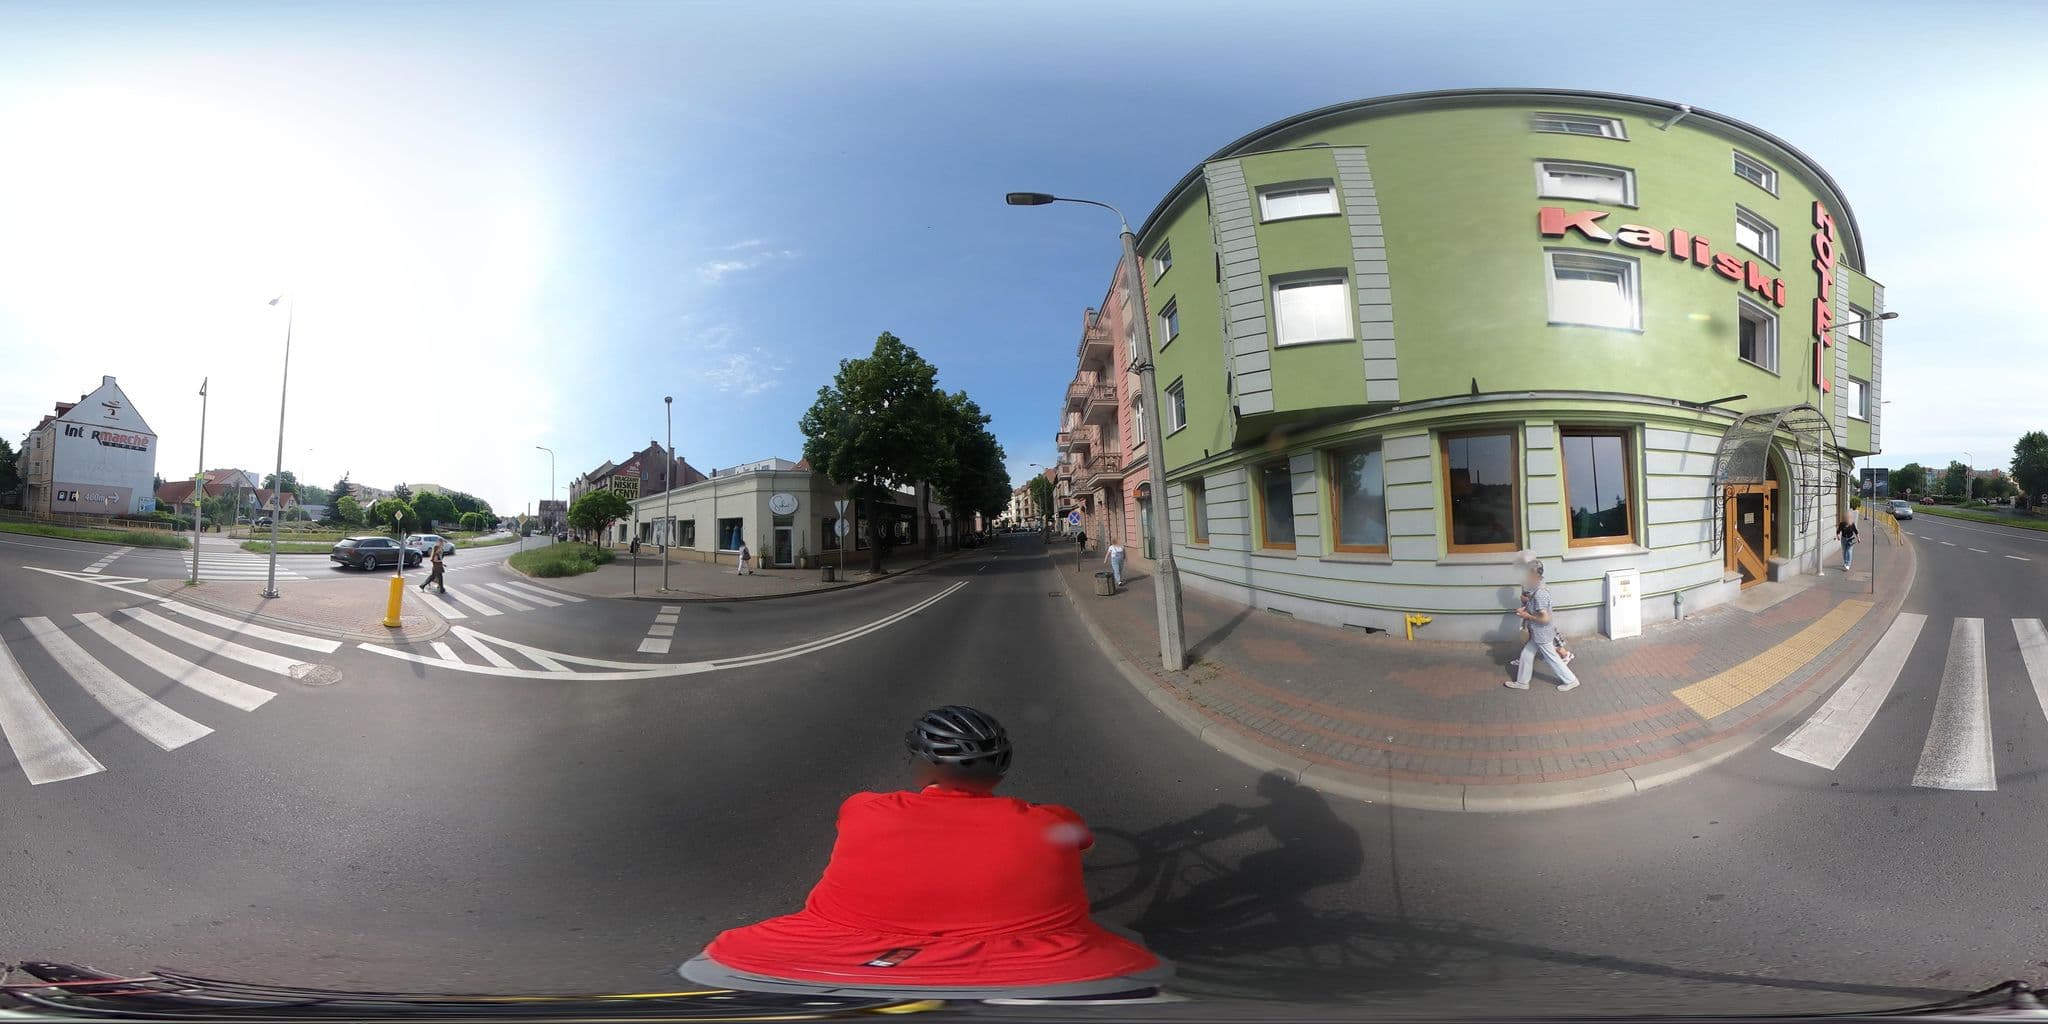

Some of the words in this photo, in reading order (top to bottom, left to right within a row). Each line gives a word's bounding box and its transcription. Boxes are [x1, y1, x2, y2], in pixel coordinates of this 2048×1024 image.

[1539, 207, 1786, 308] Kaliski
[1812, 200, 1834, 393] HOTEL
[614, 481, 639, 490] NISKIE
